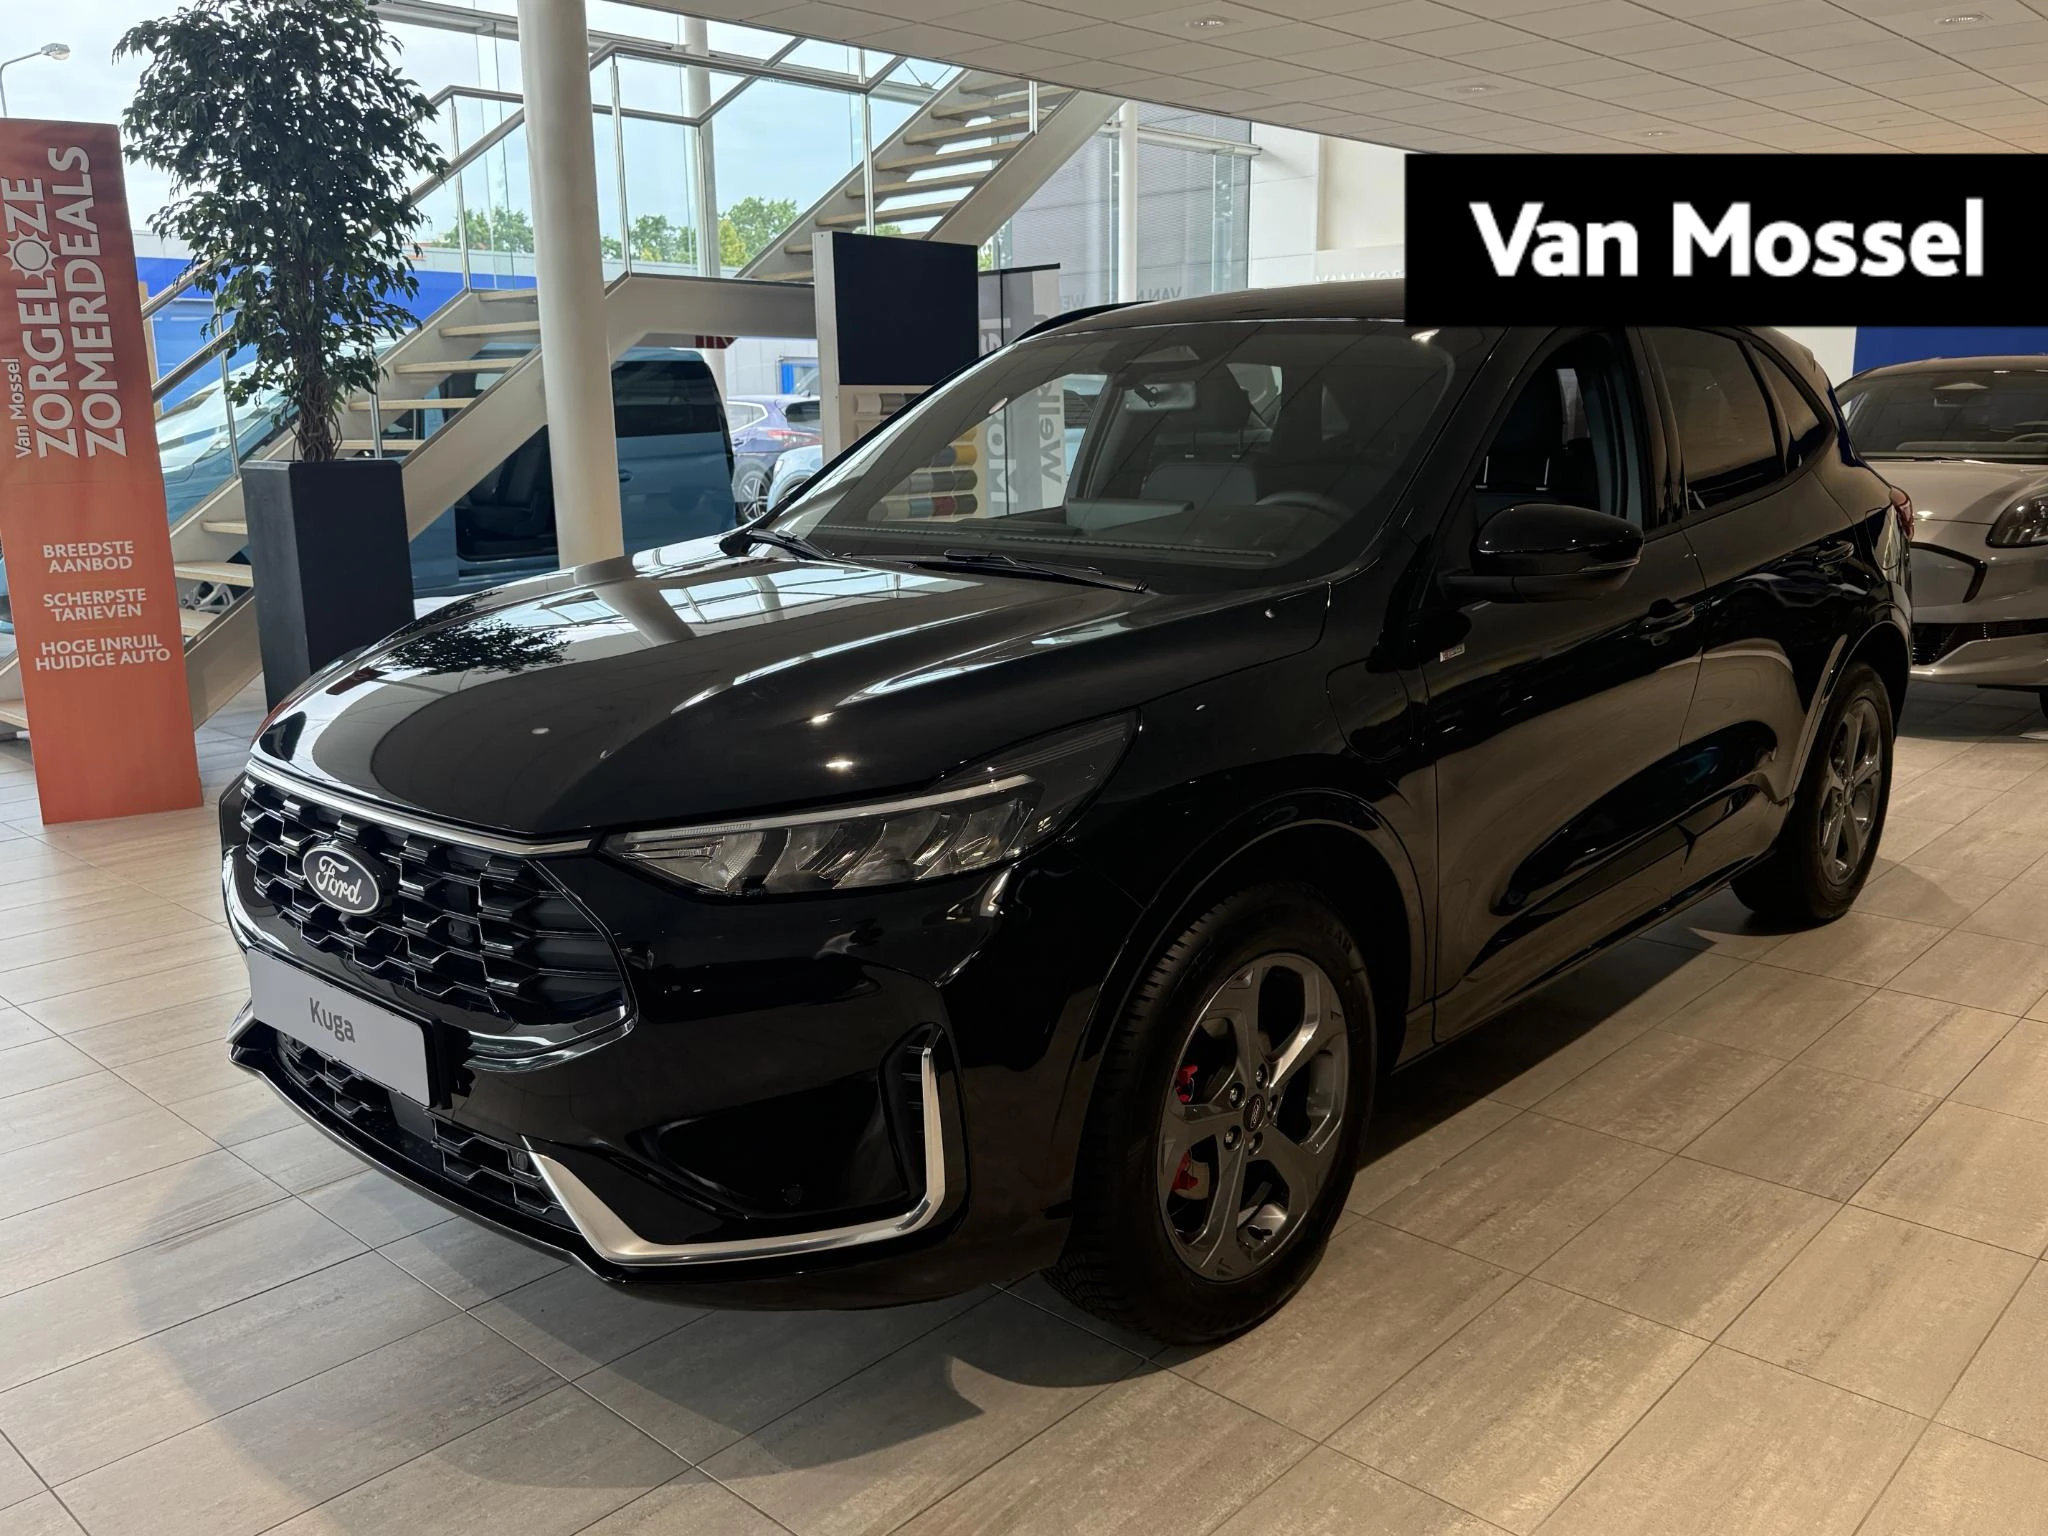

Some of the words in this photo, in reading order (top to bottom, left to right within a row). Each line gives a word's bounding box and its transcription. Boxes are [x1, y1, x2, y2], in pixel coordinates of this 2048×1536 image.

[48, 146, 128, 457] ZOMERDEALS
[1, 358, 27, 420] Mossel
[14, 425, 32, 458] Van
[43, 540, 134, 558] BREEDSTE
[49, 556, 133, 573] AANBOD
[43, 588, 147, 607] SCHERPSTE
[51, 603, 142, 622] TARIEVEN
[41, 639, 97, 655] HOGE
[100, 634, 163, 650] INRUIL
[35, 652, 116, 671] HUIDIGE
[119, 648, 171, 665] AUTO
[316, 856, 362, 904] Ford
[309, 997, 355, 1043] Kuga
